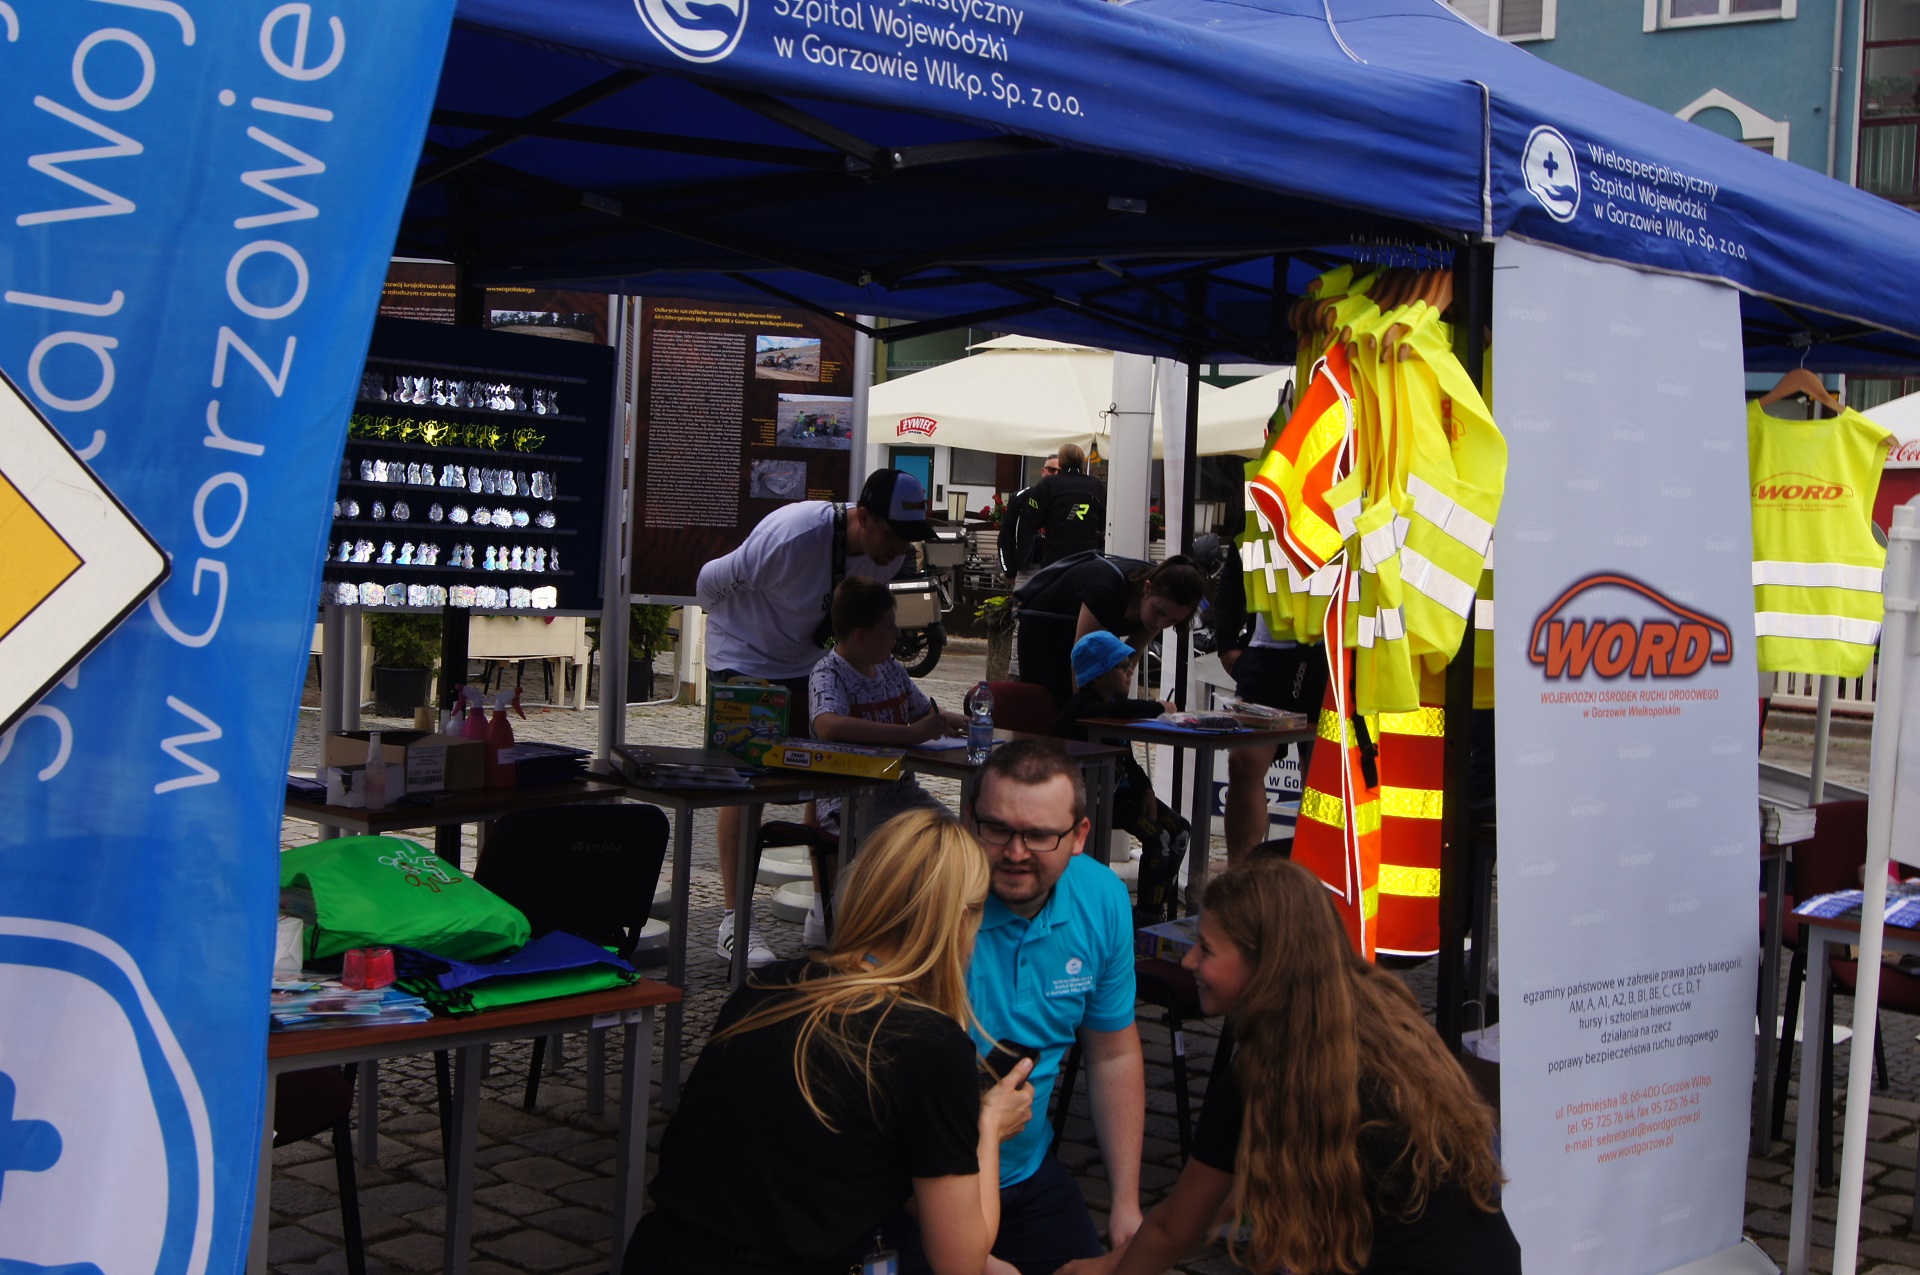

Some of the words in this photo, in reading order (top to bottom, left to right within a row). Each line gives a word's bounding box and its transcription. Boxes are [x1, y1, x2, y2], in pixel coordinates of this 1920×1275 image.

[774, 0, 865, 30] Szpital
[870, 4, 1008, 62] Wojewódzki
[774, 36, 794, 59] w
[802, 34, 918, 81] Gorzowie
[924, 57, 987, 100] Wlkp.
[991, 72, 1026, 108] Sp.
[1031, 88, 1043, 108] z
[1047, 92, 1085, 117] o.o.
[1587, 143, 1718, 202] Wielospecjalistyczny
[1590, 171, 1636, 202] Szpital
[1638, 185, 1708, 221] Wojewódzki
[1593, 203, 1603, 219] w
[1606, 203, 1663, 235] Gorzowie
[1665, 217, 1698, 245] Wlkp.
[1699, 228, 1718, 253] Sp.
[1720, 238, 1727, 252] z
[1728, 242, 1748, 260] o.o.
[902, 417, 934, 431] ŻYWIEC
[1758, 485, 1844, 500] WORD
[1545, 619, 1713, 679] WORD
[1292, 661, 1307, 699] adidas
[1541, 689, 1597, 704] WOJEWÓDZKI
[1598, 689, 1638, 703] OŚRODEK
[1640, 690, 1667, 702] RUCHU
[1669, 689, 1719, 702] DROGOWEGO
[716, 714, 747, 722] Drogowe
[723, 703, 742, 711] Znaki
[1583, 710, 1590, 718] w
[1592, 707, 1627, 718] Gorzowie
[1628, 705, 1681, 719] Wielkopolskim
[154, 695, 223, 794] w
[1269, 776, 1280, 787] w
[1284, 775, 1302, 789] Go
[1523, 986, 1566, 1005] egzaminy
[1567, 979, 1615, 998] państwowe
[1617, 979, 1625, 988] w
[1627, 972, 1660, 987] zakresie
[1661, 969, 1685, 983] prawa
[1686, 963, 1707, 977] jazdy
[1708, 957, 1743, 974] kategorii:
[1569, 1001, 1586, 1014] AM,
[1587, 998, 1596, 1011] A,
[1612, 993, 1627, 1007] A2,
[1628, 991, 1637, 1004] B,
[1649, 987, 1662, 1000] BE,
[1663, 985, 1671, 998] C,
[1672, 983, 1685, 996] CE,
[1686, 981, 1695, 994] D,
[1696, 980, 1701, 992] T
[1579, 1016, 1603, 1029] kursy
[1610, 1007, 1649, 1025] szkolenia
[1650, 1001, 1691, 1017] kierowców
[1600, 1028, 1639, 1044] działania
[1641, 1026, 1650, 1036] na
[1651, 1021, 1672, 1033] rzecz
[1548, 1056, 1583, 1075] poprawy
[1585, 1042, 1651, 1064] bezpieczeństwa
[1652, 1038, 1675, 1051] ruchu
[1677, 1028, 1719, 1048] drogowego
[1556, 1108, 1565, 1120] ul.
[1567, 1098, 1618, 1119] Podmiejska
[1630, 1086, 1660, 1103] 66-400
[1661, 1081, 1690, 1095] Gorzów
[1567, 1123, 1579, 1135] tel.
[1582, 1118, 1594, 1131] 95
[1596, 1115, 1612, 1128] 725
[1614, 1112, 1623, 1125] 76
[1624, 1109, 1636, 1122] 44,
[1637, 1106, 1649, 1119] fax
[1651, 1104, 1662, 1115] 95
[1663, 1100, 1678, 1113] 725
[1679, 1097, 1688, 1108] 76
[1689, 1093, 1700, 1105] 43
[1565, 1137, 1594, 1153] e-mail:
[1596, 1109, 1701, 1147] sekretariat@wordgorzow.pl
[1597, 1133, 1674, 1164] www.wordgorzow.pl
